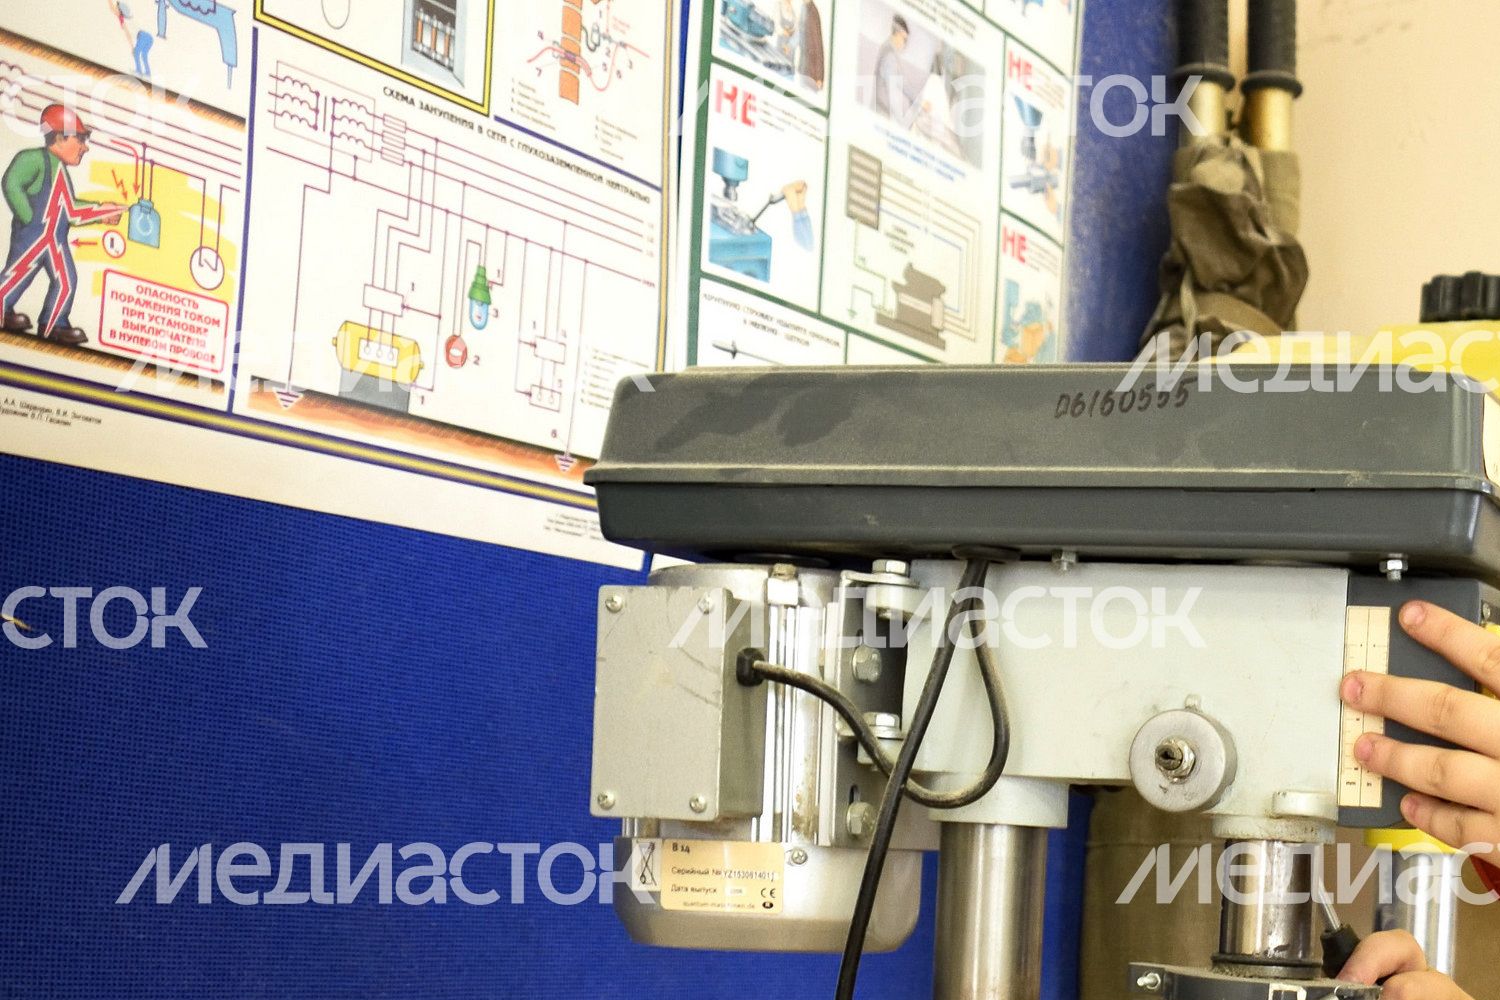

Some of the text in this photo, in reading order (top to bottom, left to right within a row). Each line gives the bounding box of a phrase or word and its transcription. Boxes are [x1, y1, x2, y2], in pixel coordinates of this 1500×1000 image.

[383, 86, 415, 106] СХЕМА
[715, 79, 757, 128] НЕ
[1001, 225, 1026, 264] НЕ
[111, 290, 220, 327] ПОРАЖЕНИЯ ТОКОМ
[136, 285, 199, 309] ОПАСНОСТЬ
[122, 306, 209, 336] ПРИ УСТАНОВКЕ
